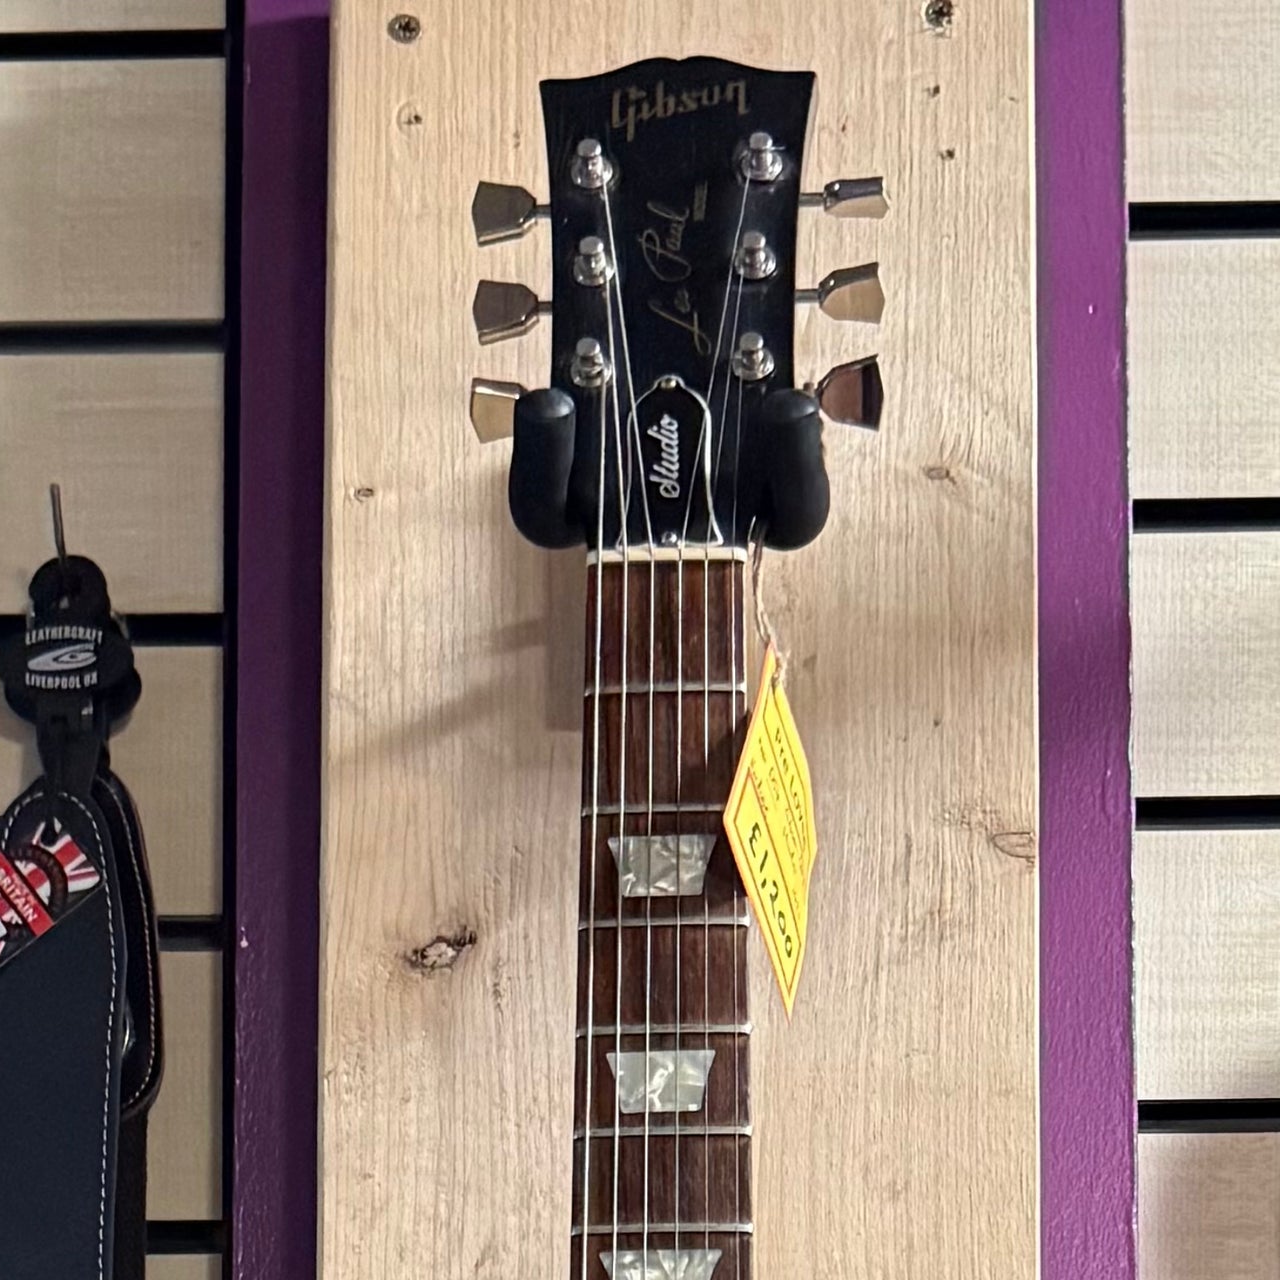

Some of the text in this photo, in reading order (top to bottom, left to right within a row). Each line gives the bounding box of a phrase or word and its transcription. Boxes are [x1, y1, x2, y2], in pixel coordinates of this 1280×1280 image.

[611, 79, 751, 142] Gibson
[647, 413, 679, 498] Studio
[25, 672, 98, 689] LIVERPOOL UK
[749, 822, 793, 958] £1,200
